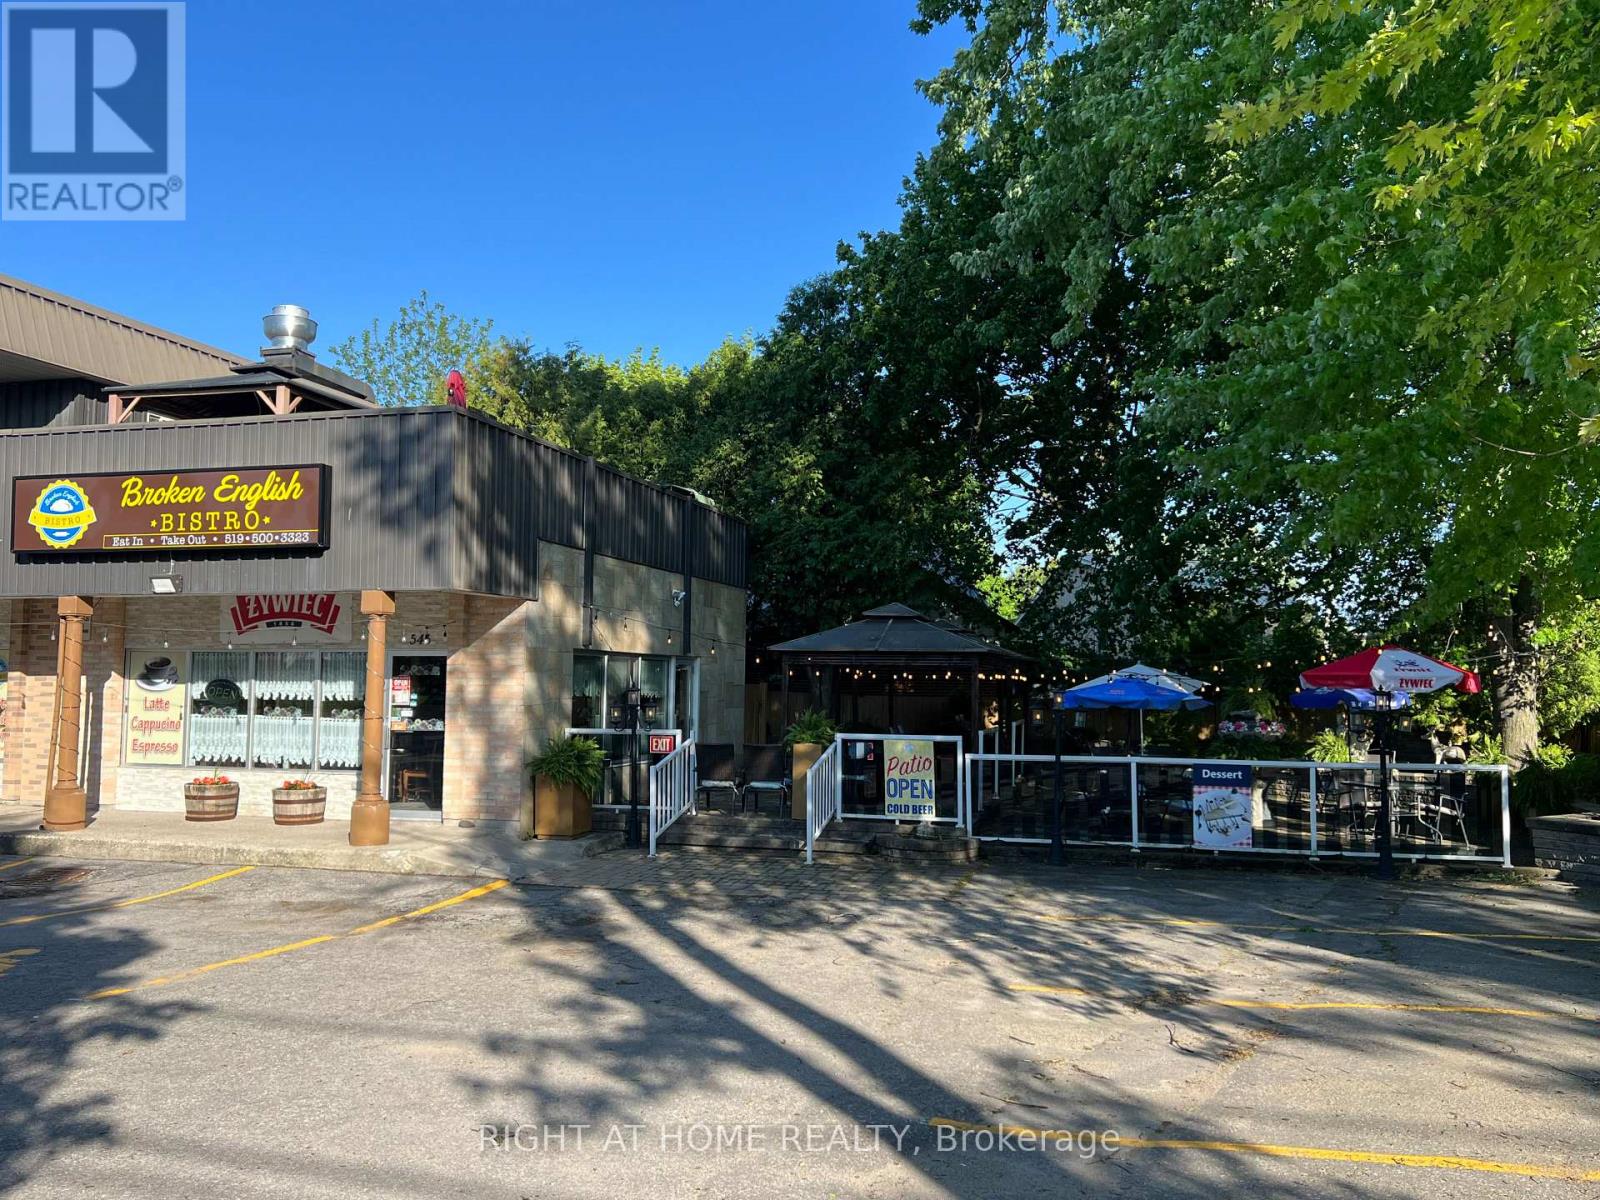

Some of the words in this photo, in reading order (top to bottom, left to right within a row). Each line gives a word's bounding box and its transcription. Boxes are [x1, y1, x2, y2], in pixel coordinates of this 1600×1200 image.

[121, 475, 206, 508] Broken
[213, 470, 304, 511] English
[44, 515, 81, 526] BISTRO
[160, 510, 260, 532] BISTRO
[112, 537, 130, 547] Eat
[132, 536, 144, 546] In
[161, 535, 186, 545] Take
[187, 534, 207, 545] Out
[409, 633, 432, 645] 545
[207, 686, 239, 699] OPEN
[143, 696, 170, 711] Latte
[131, 716, 181, 736] Cappucino
[131, 738, 179, 758] Espresso
[652, 738, 671, 751] EXIT
[887, 754, 932, 777] Patio
[1202, 769, 1242, 779] Dessert
[886, 777, 933, 799] OPEN
[887, 803, 910, 814] COLD
[911, 804, 933, 815] BEER
